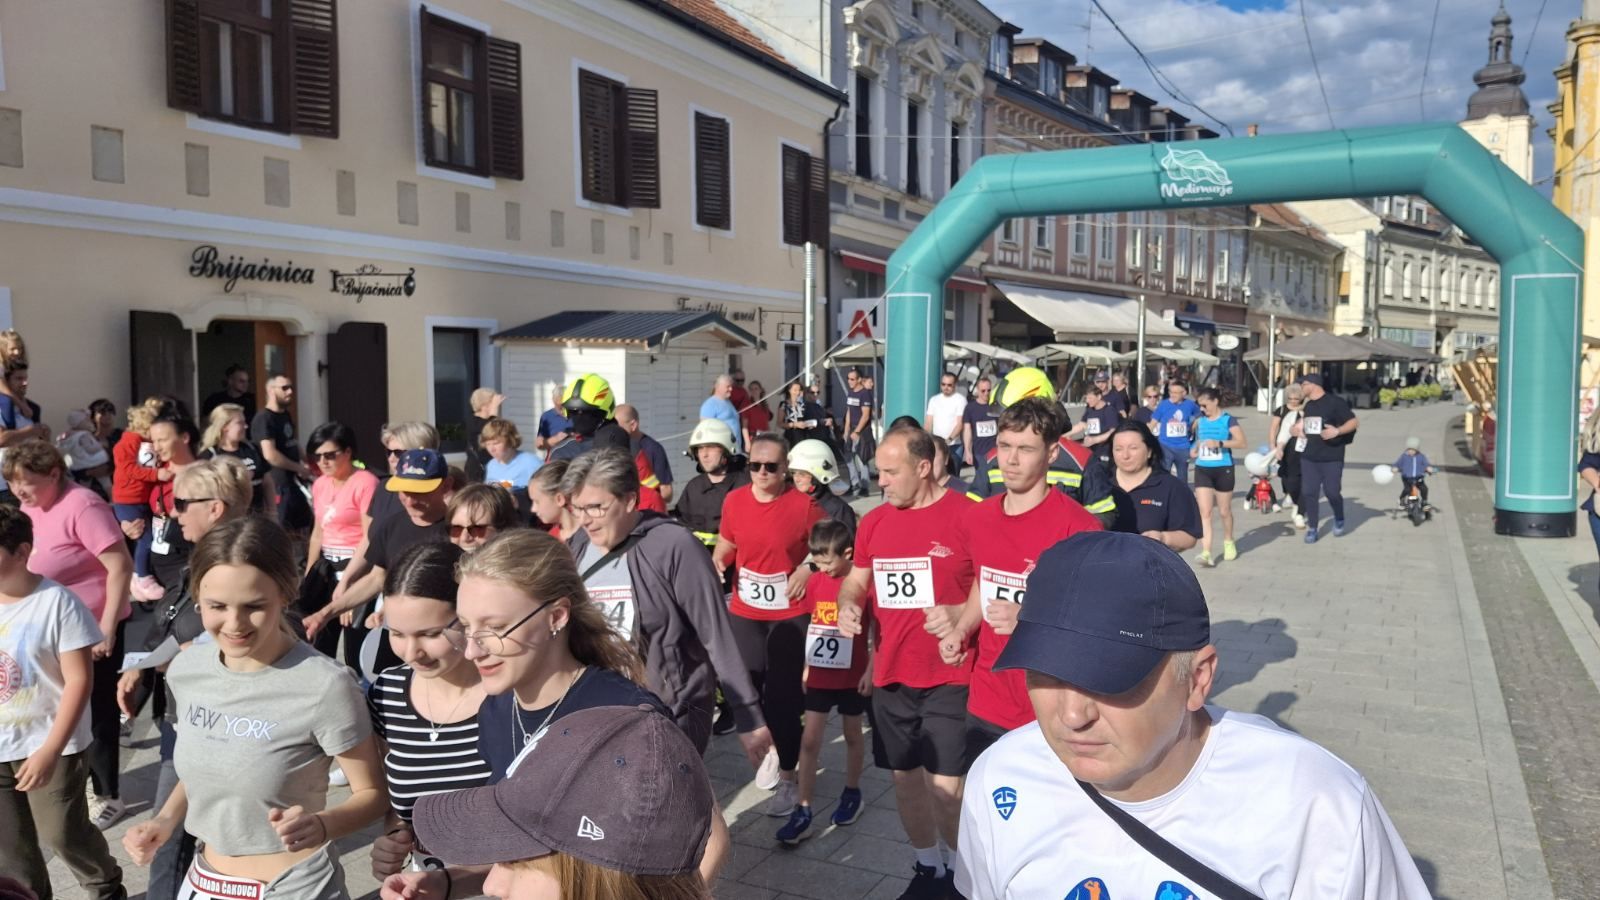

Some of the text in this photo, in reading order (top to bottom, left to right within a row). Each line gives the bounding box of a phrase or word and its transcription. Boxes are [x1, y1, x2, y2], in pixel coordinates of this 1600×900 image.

[847, 304, 877, 339] A1
[750, 582, 776, 602] 30
[886, 571, 917, 598] 58
[813, 636, 840, 660] 29
[185, 703, 280, 741] NEW YORK
[221, 880, 258, 899] ČAKOVCA
